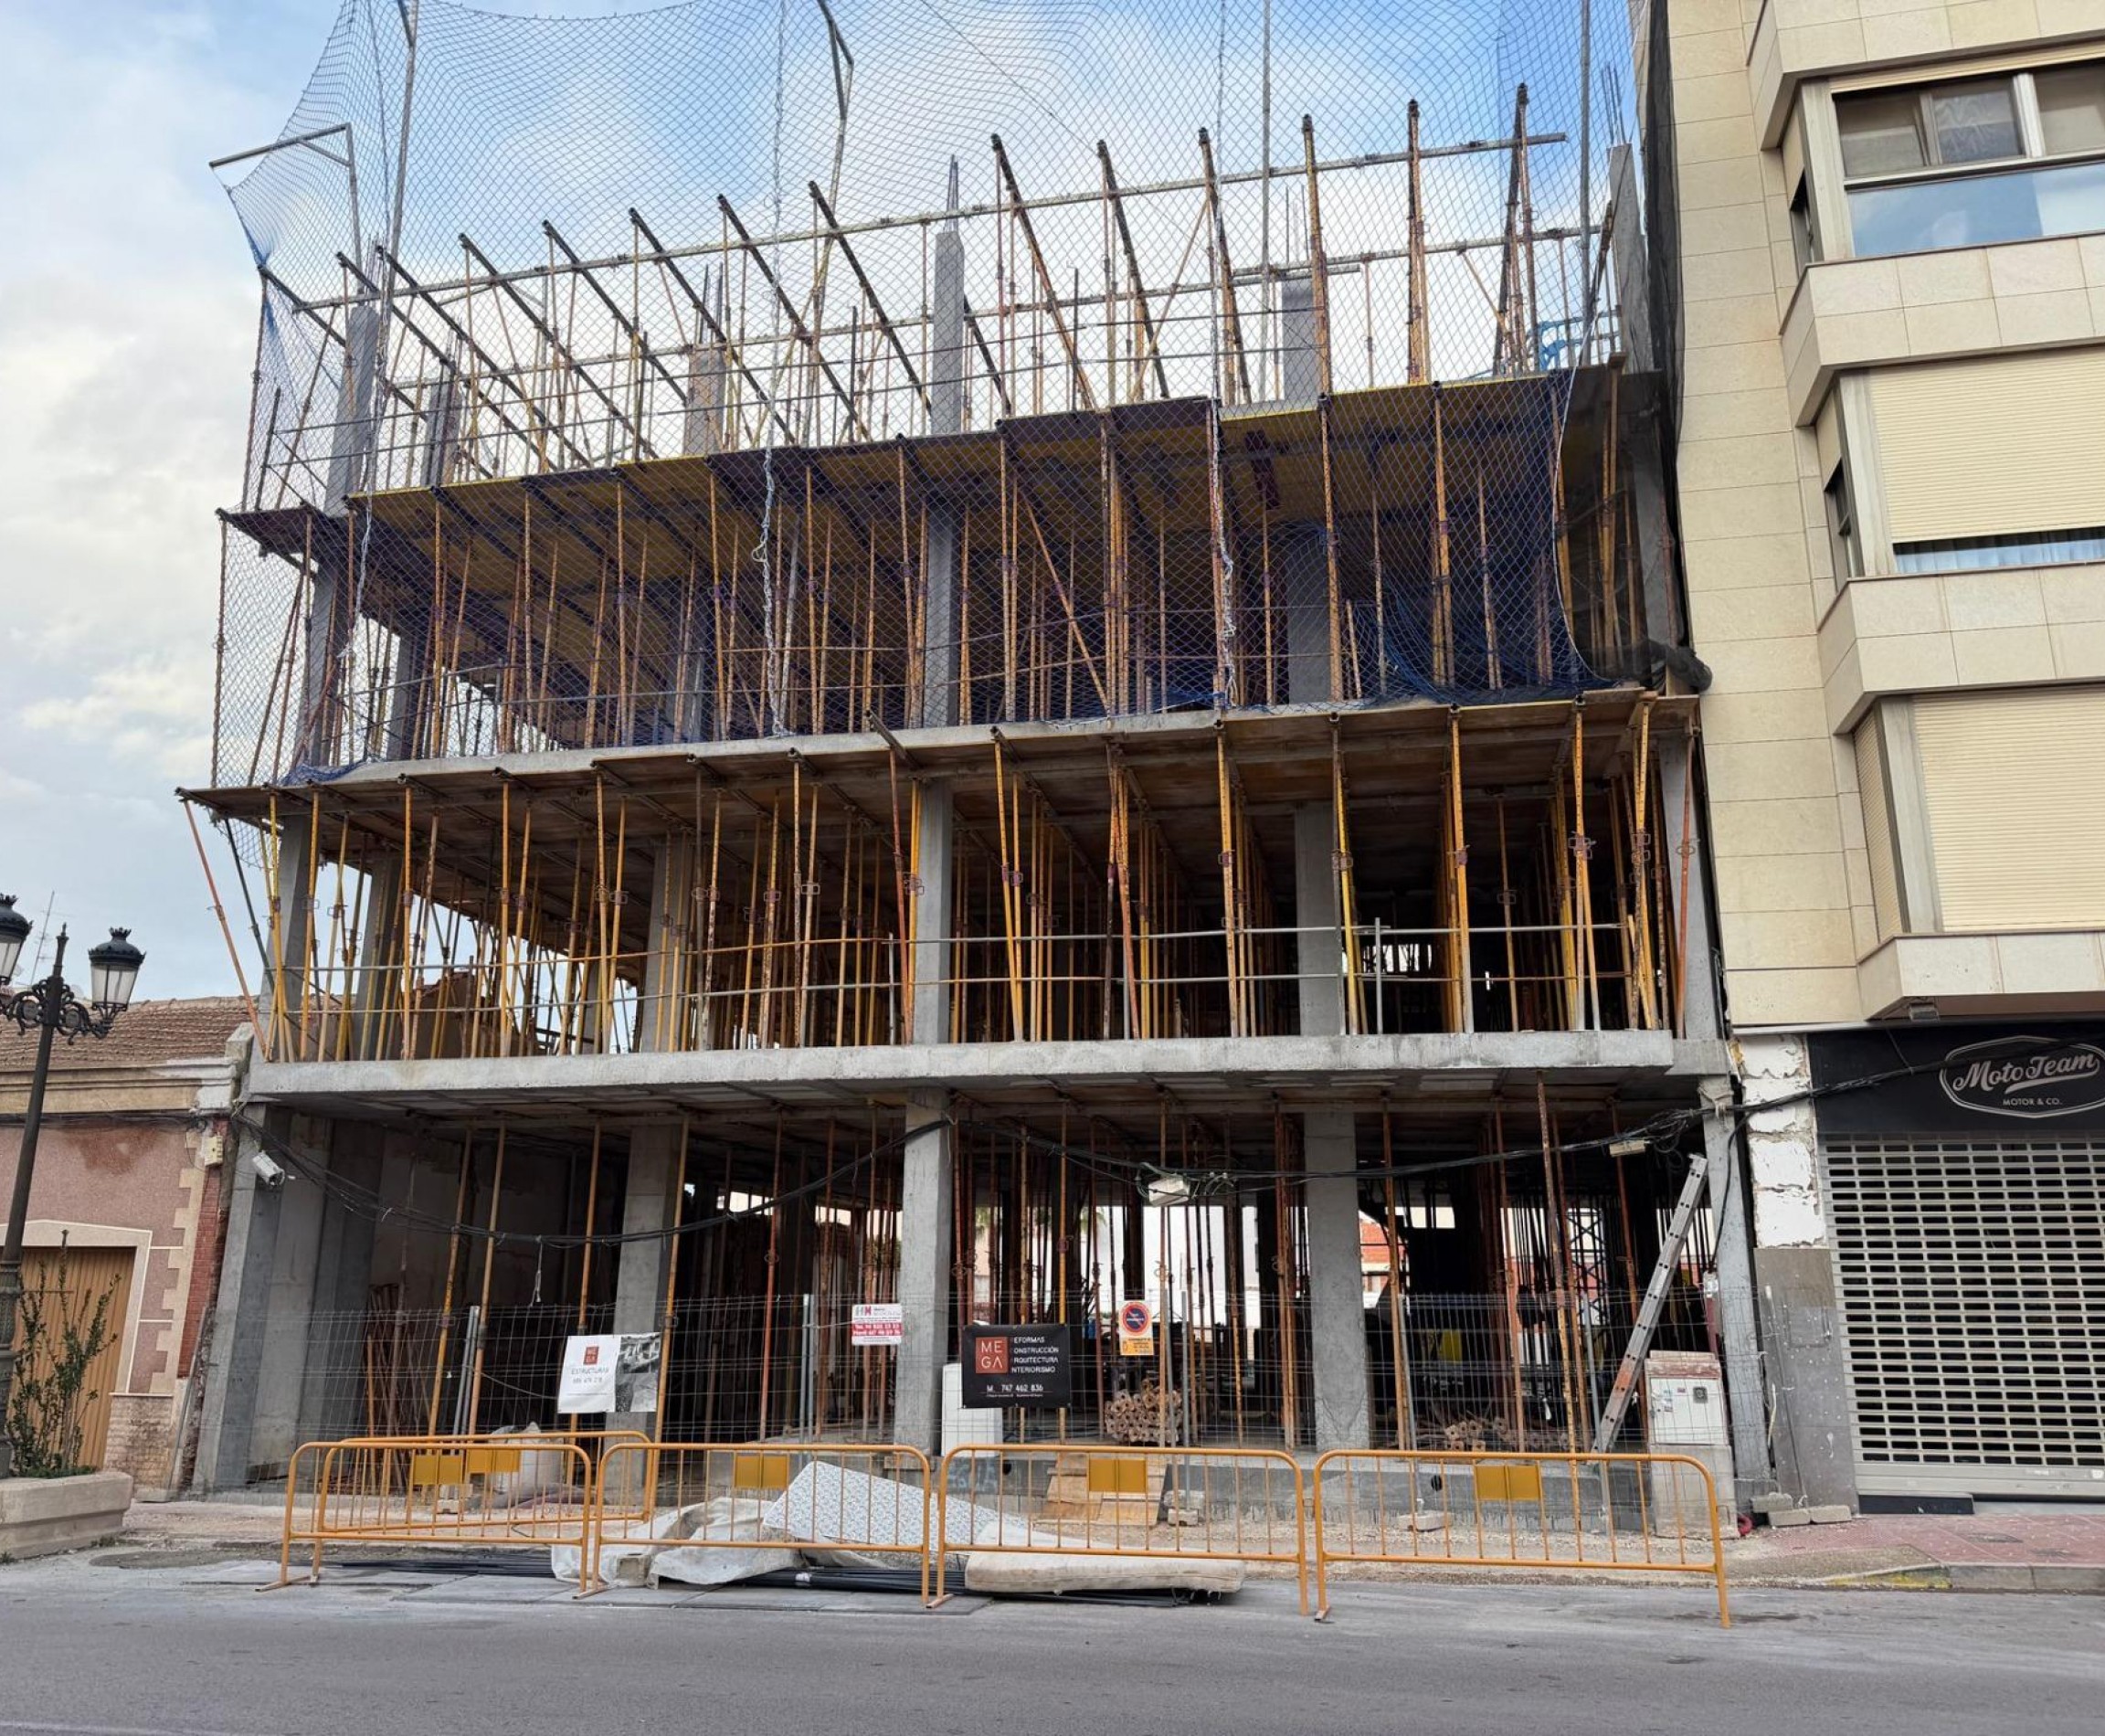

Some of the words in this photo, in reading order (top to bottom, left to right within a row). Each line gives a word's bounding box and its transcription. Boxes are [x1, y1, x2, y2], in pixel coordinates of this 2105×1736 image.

[2002, 1098, 2035, 1106] MOTOR
[2036, 1097, 2044, 1106] &
[2046, 1097, 2063, 1106] CO.
